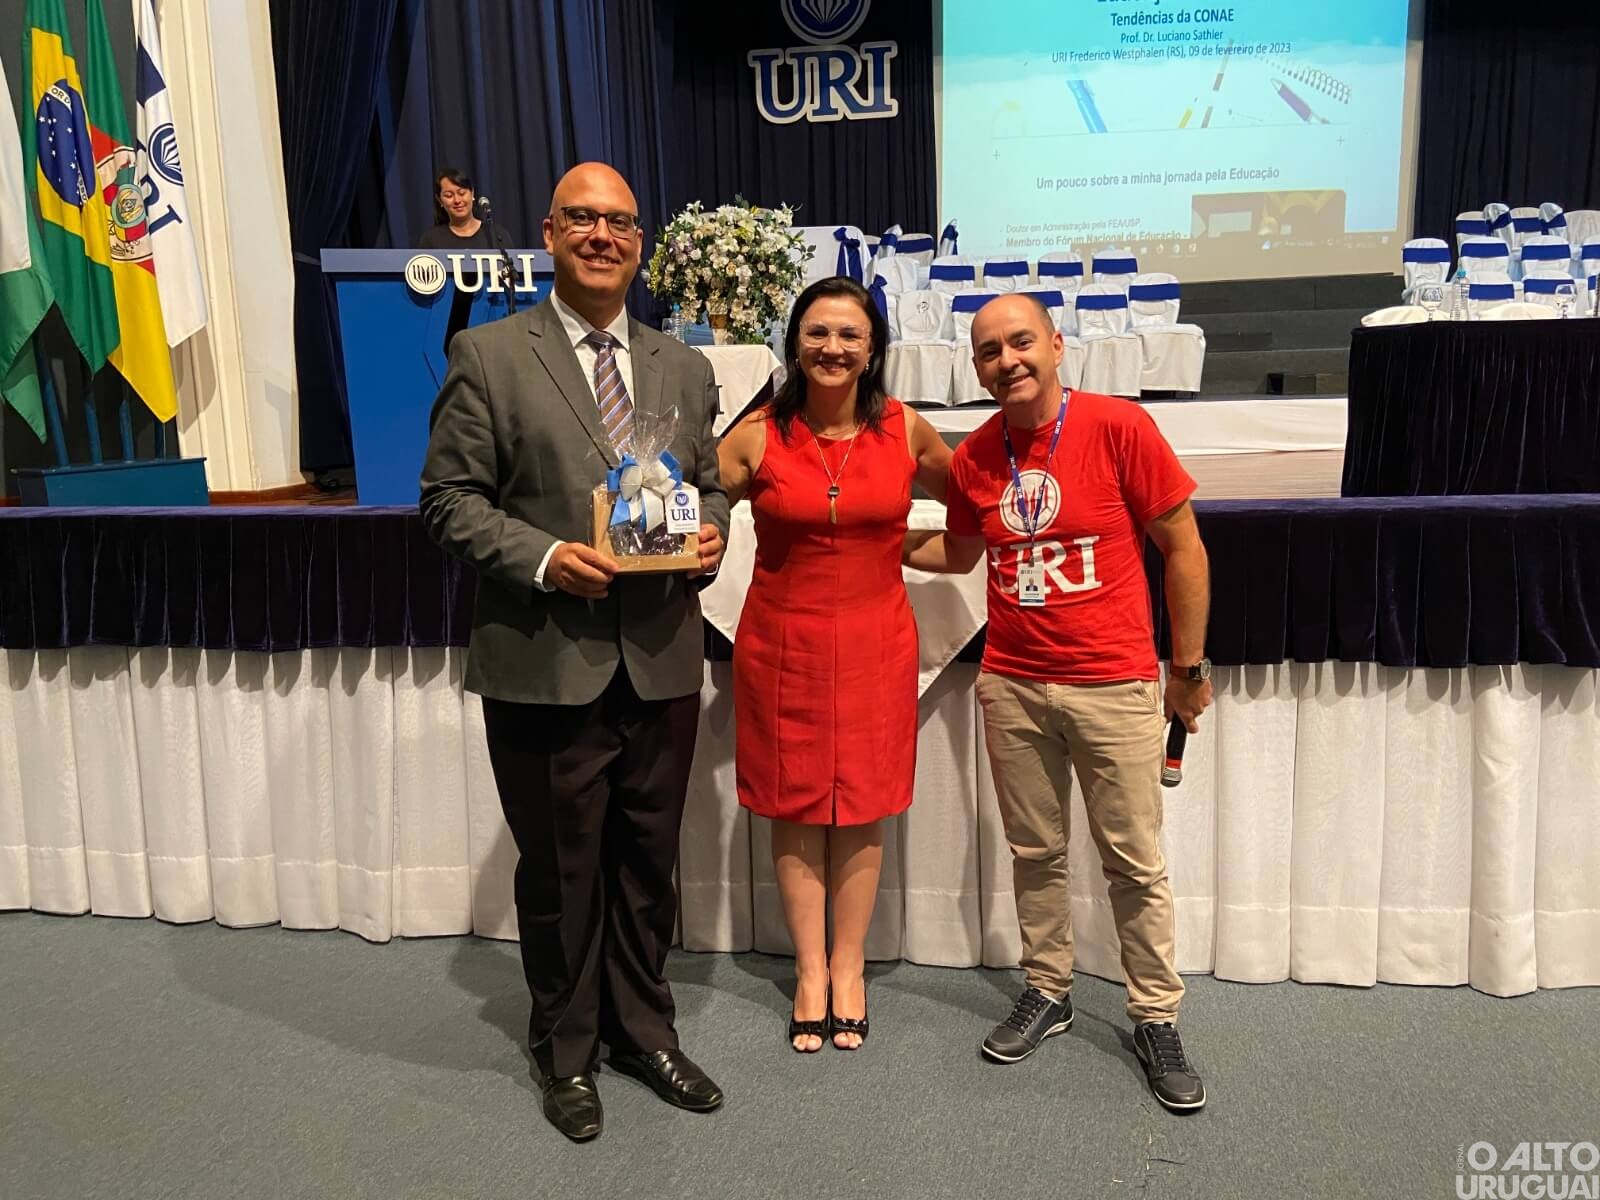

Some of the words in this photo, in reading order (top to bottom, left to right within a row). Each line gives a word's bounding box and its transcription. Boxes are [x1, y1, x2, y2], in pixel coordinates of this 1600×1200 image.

[1110, 10, 1174, 26] Tendências
[1176, 9, 1191, 23] da
[1194, 8, 1234, 23] CONAE
[1120, 31, 1140, 43] Prof.
[1143, 31, 1155, 42] Dr.
[1157, 29, 1191, 42] Luciano
[1052, 51, 1068, 63] URI
[1070, 50, 1111, 62] Frederico
[1113, 47, 1165, 61] Westphalen
[1166, 45, 1186, 58] (RS),
[1188, 45, 1200, 56] 09
[1202, 45, 1213, 56] de
[1215, 43, 1254, 56] fevereiro
[1256, 42, 1267, 54] de
[1269, 42, 1291, 54] 2023
[748, 41, 898, 124] URI
[1036, 176, 1054, 189] Um
[1056, 177, 1088, 191] pouco
[1090, 174, 1119, 187] sobre
[1121, 175, 1128, 185] a
[1130, 172, 1162, 185] minha
[1163, 170, 1203, 186] jornada
[1205, 168, 1227, 184] pela
[1229, 166, 1280, 181] Educação
[1006, 236, 1041, 248] Membro
[1043, 236, 1055, 246] do
[447, 254, 538, 293] URI
[671, 508, 696, 521] URI
